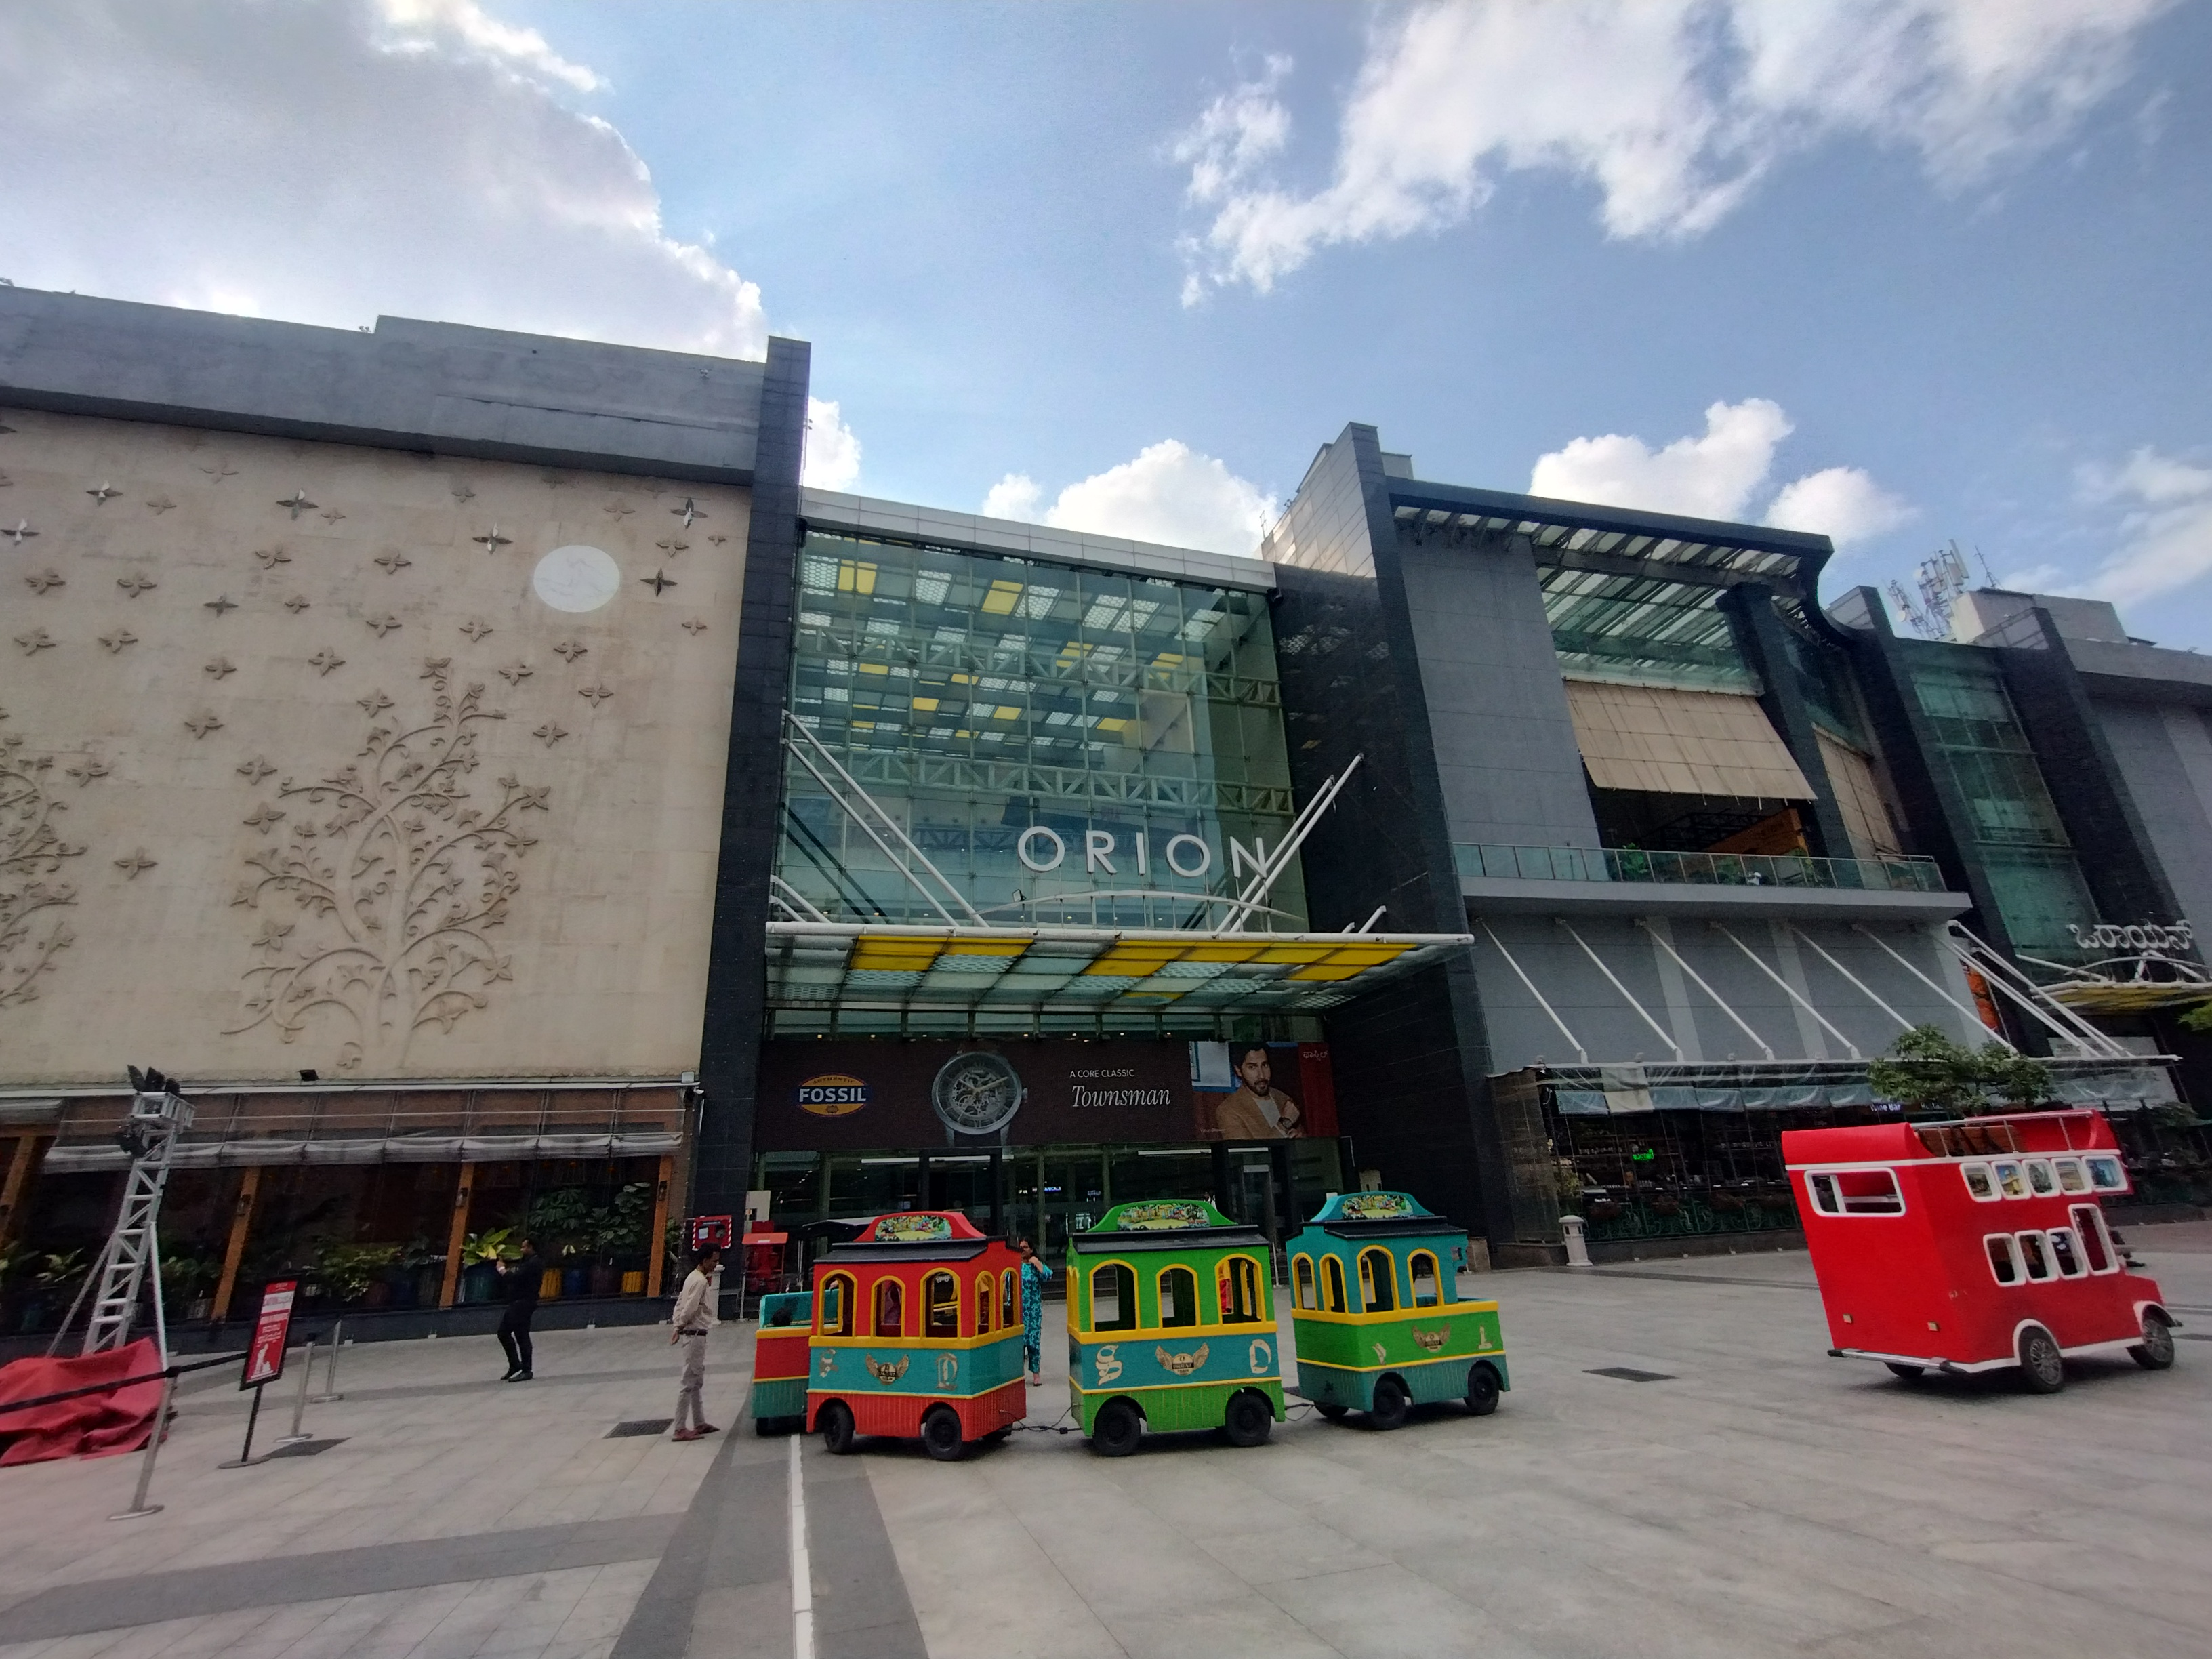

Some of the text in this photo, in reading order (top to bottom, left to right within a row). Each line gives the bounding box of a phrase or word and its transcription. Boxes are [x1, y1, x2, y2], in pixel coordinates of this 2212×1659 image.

[1018, 825, 1267, 879] ORION
[1078, 1069, 1099, 1078] CORE
[1101, 1069, 1134, 1078] CLASSIC
[798, 1087, 867, 1103] FOSSIL
[1071, 1084, 1171, 1107] Townsman
